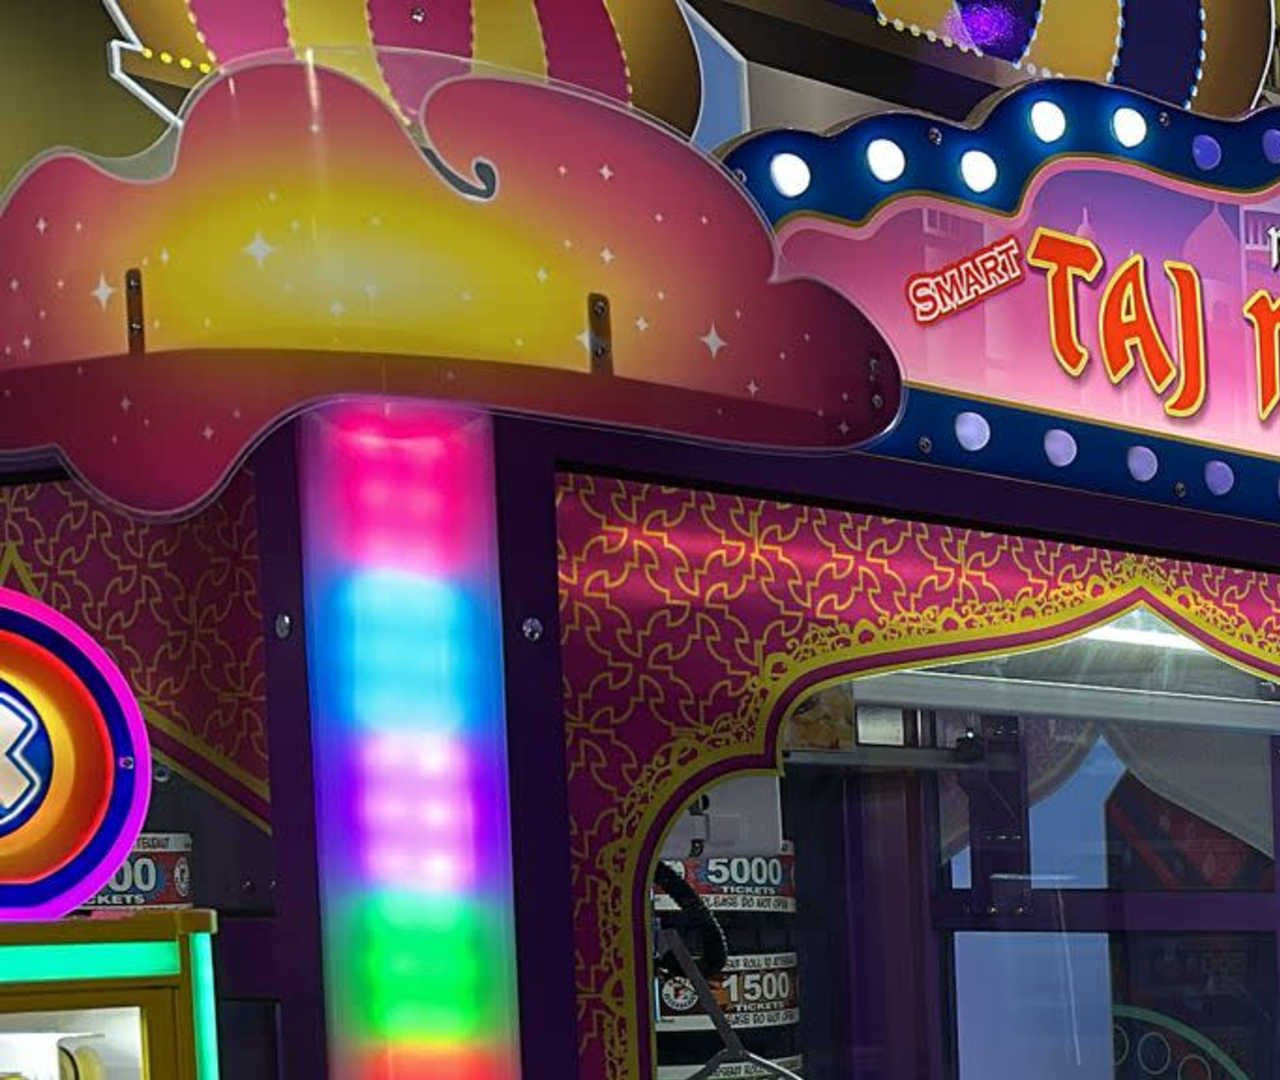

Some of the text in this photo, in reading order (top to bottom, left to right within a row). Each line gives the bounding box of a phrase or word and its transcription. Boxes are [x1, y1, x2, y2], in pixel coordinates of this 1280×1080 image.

[907, 235, 1024, 325] SMART
[1027, 226, 1207, 418] TAJ
[707, 857, 782, 886] 5000
[721, 886, 776, 896] TICKETS
[721, 972, 790, 1002] 1500
